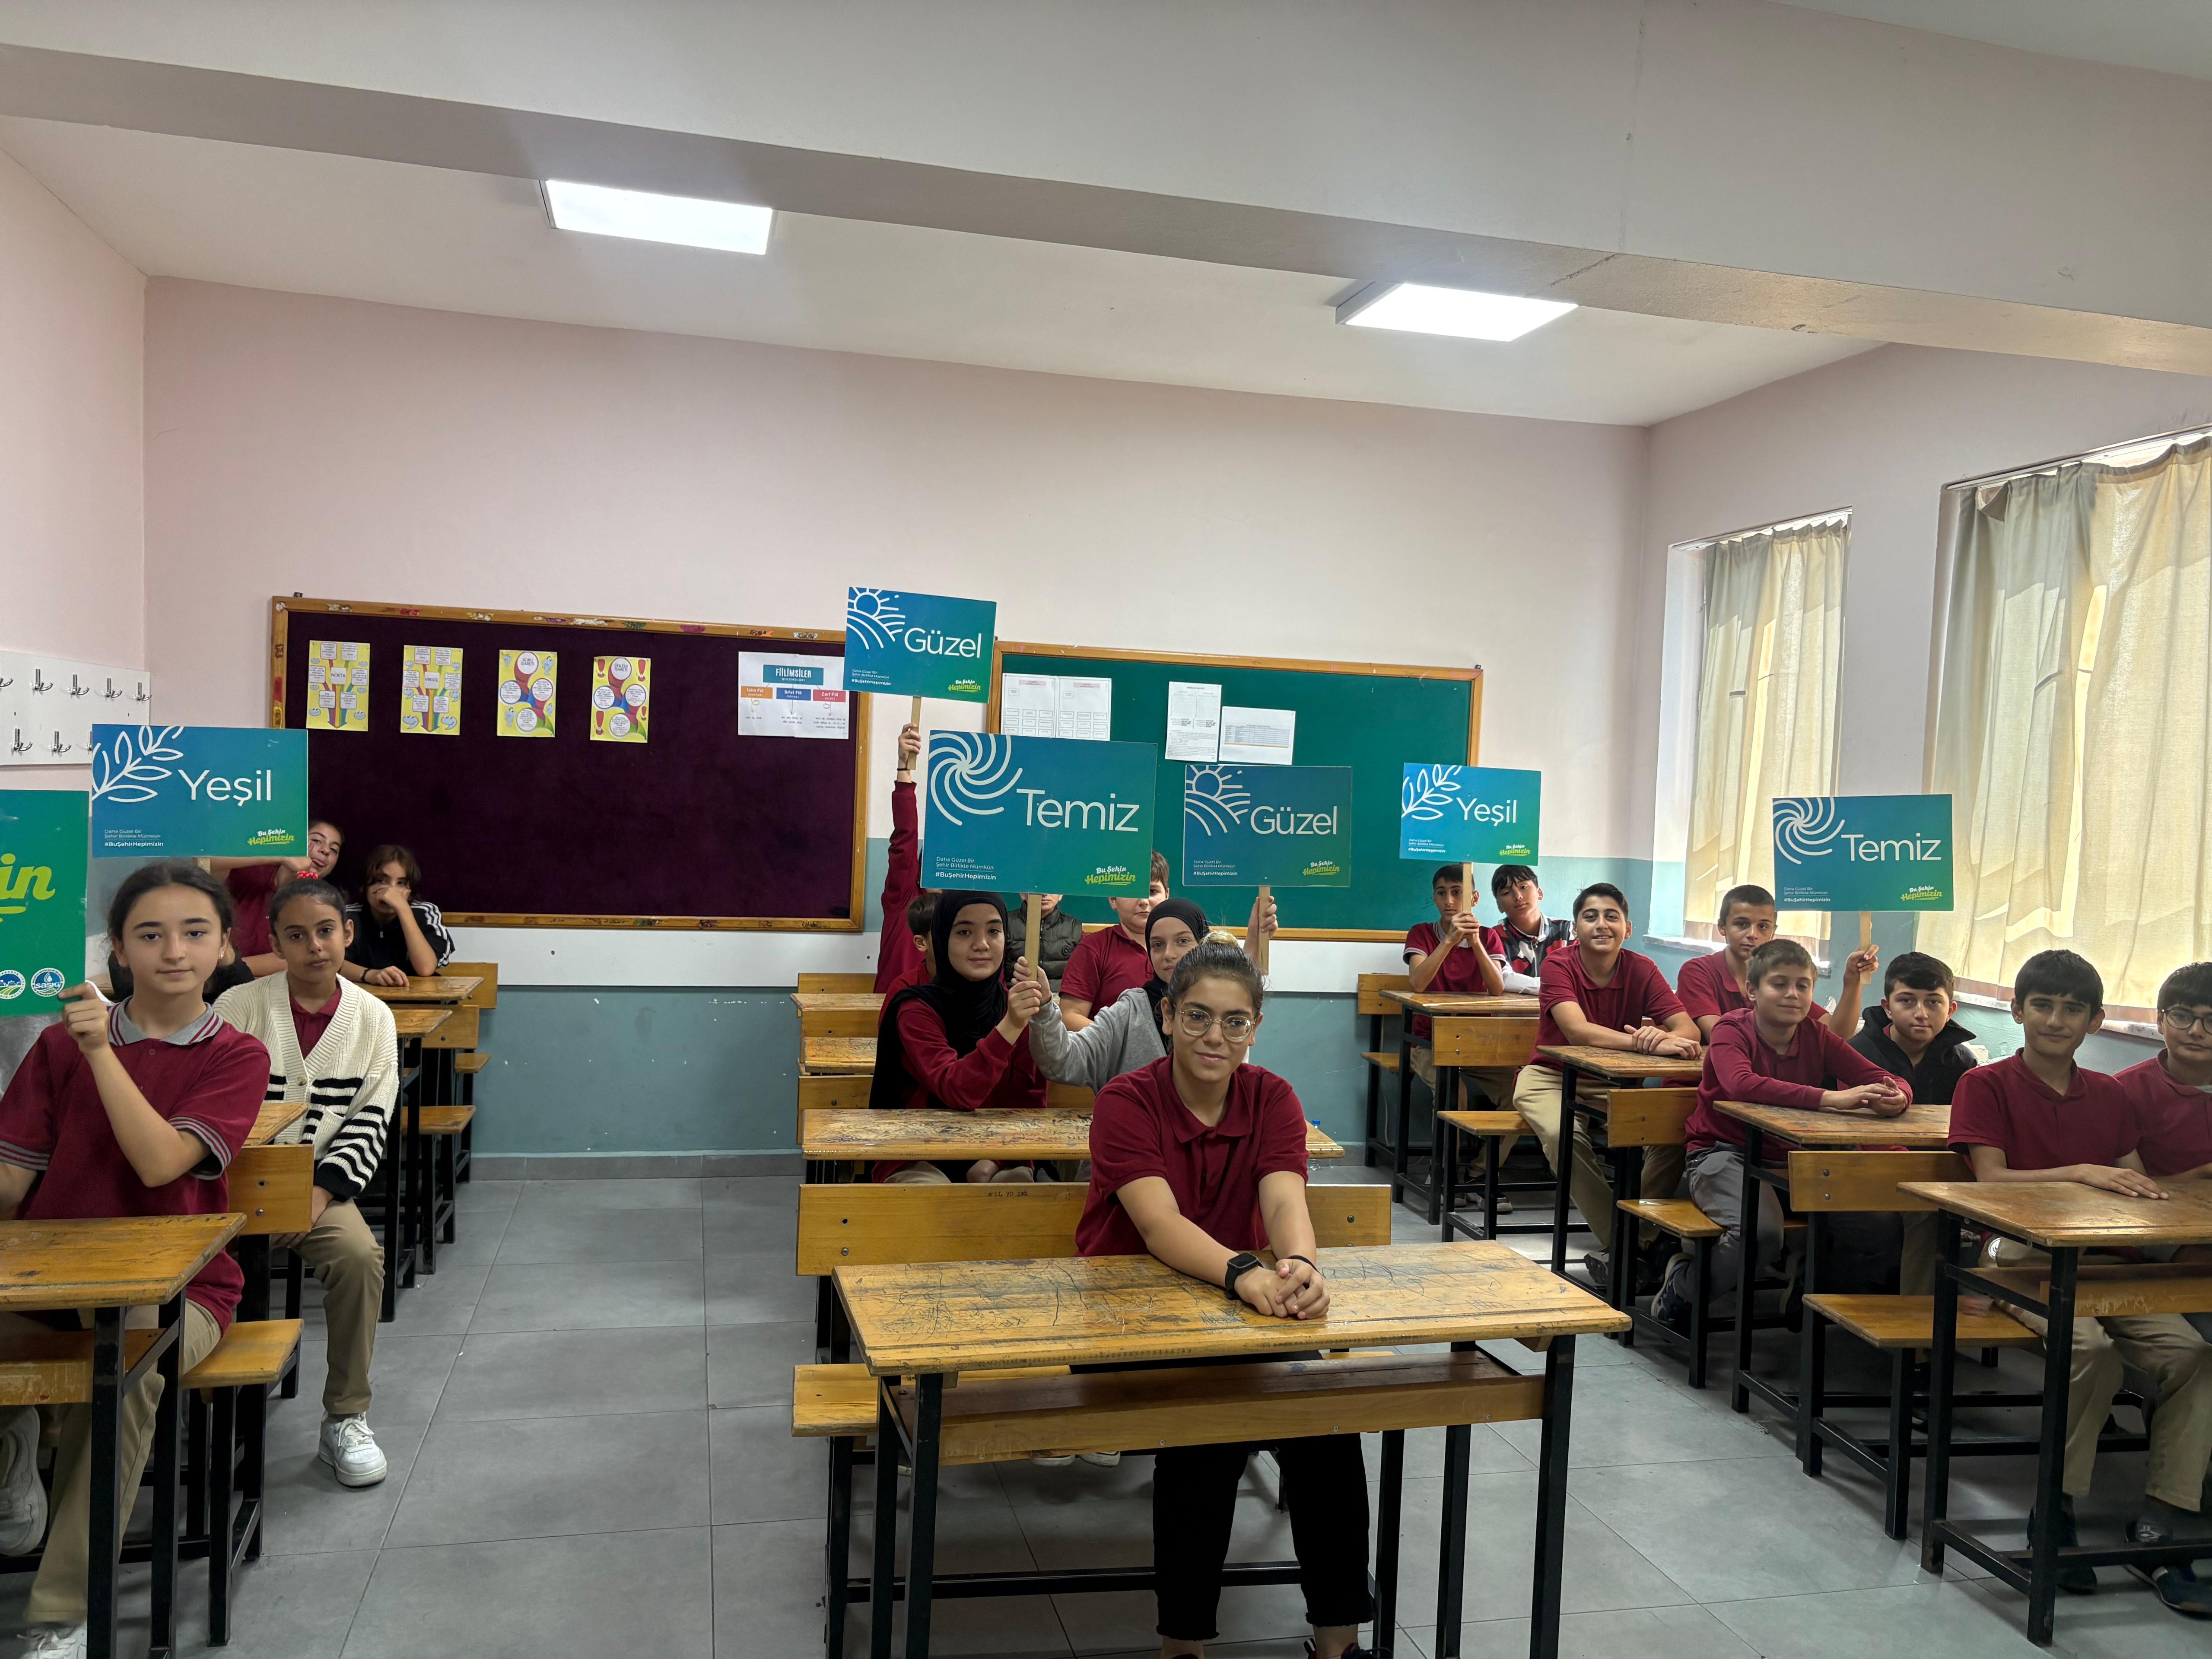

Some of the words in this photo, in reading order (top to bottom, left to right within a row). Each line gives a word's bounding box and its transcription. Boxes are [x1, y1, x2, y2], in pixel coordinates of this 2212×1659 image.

[904, 628, 982, 658] Güzel
[178, 769, 271, 807] Yeşil
[1016, 788, 1140, 832] Temiz
[1250, 805, 1337, 835] Güzel
[1456, 797, 1517, 827] Yeşil
[247, 833, 294, 845] Hepimizin
[1840, 833, 1942, 861] Temiz
[935, 871, 996, 880] #BuŞehirHepimizin
[1084, 871, 1136, 885] Hepimizin
[1107, 866, 1127, 874] Şehir
[1302, 864, 1340, 875] Hepimizin
[1900, 890, 1943, 901] Hepimizin
